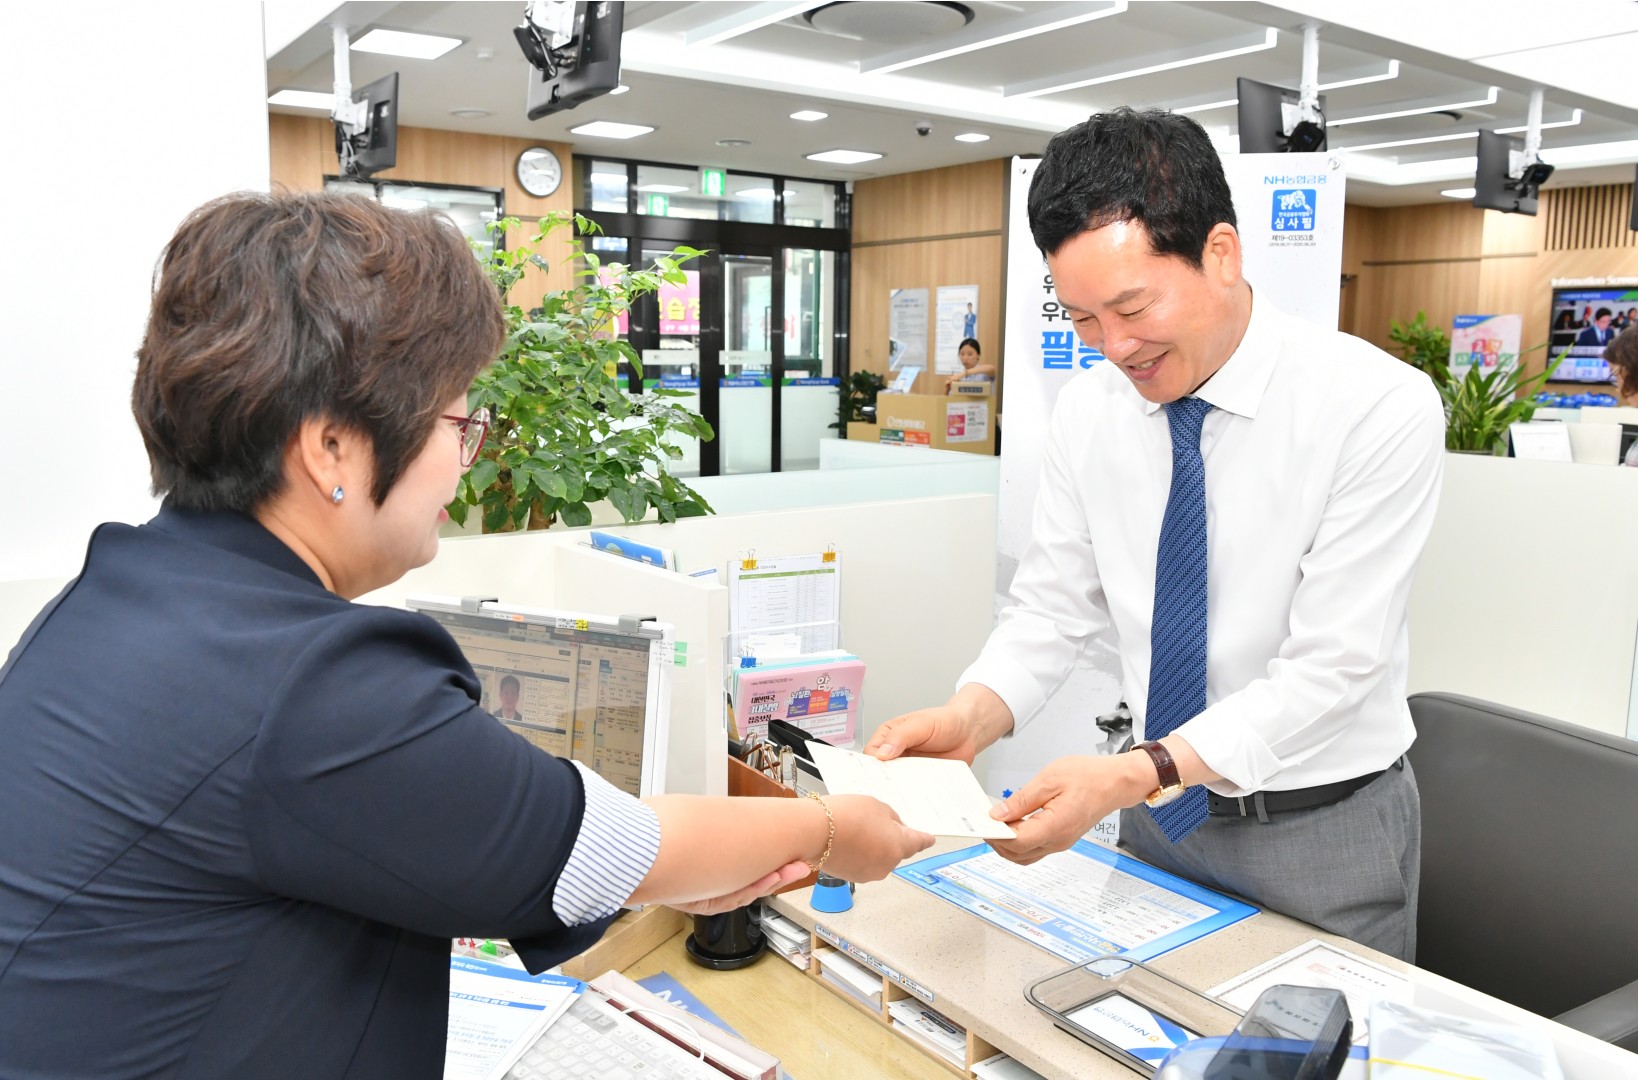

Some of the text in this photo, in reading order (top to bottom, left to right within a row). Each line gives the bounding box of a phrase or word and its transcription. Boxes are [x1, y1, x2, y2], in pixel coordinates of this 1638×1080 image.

[1263, 174, 1327, 186] NH농협금융
[1274, 217, 1312, 230] 심사필
[751, 694, 776, 704] 대한민국
[1094, 822, 1116, 835] 여건
